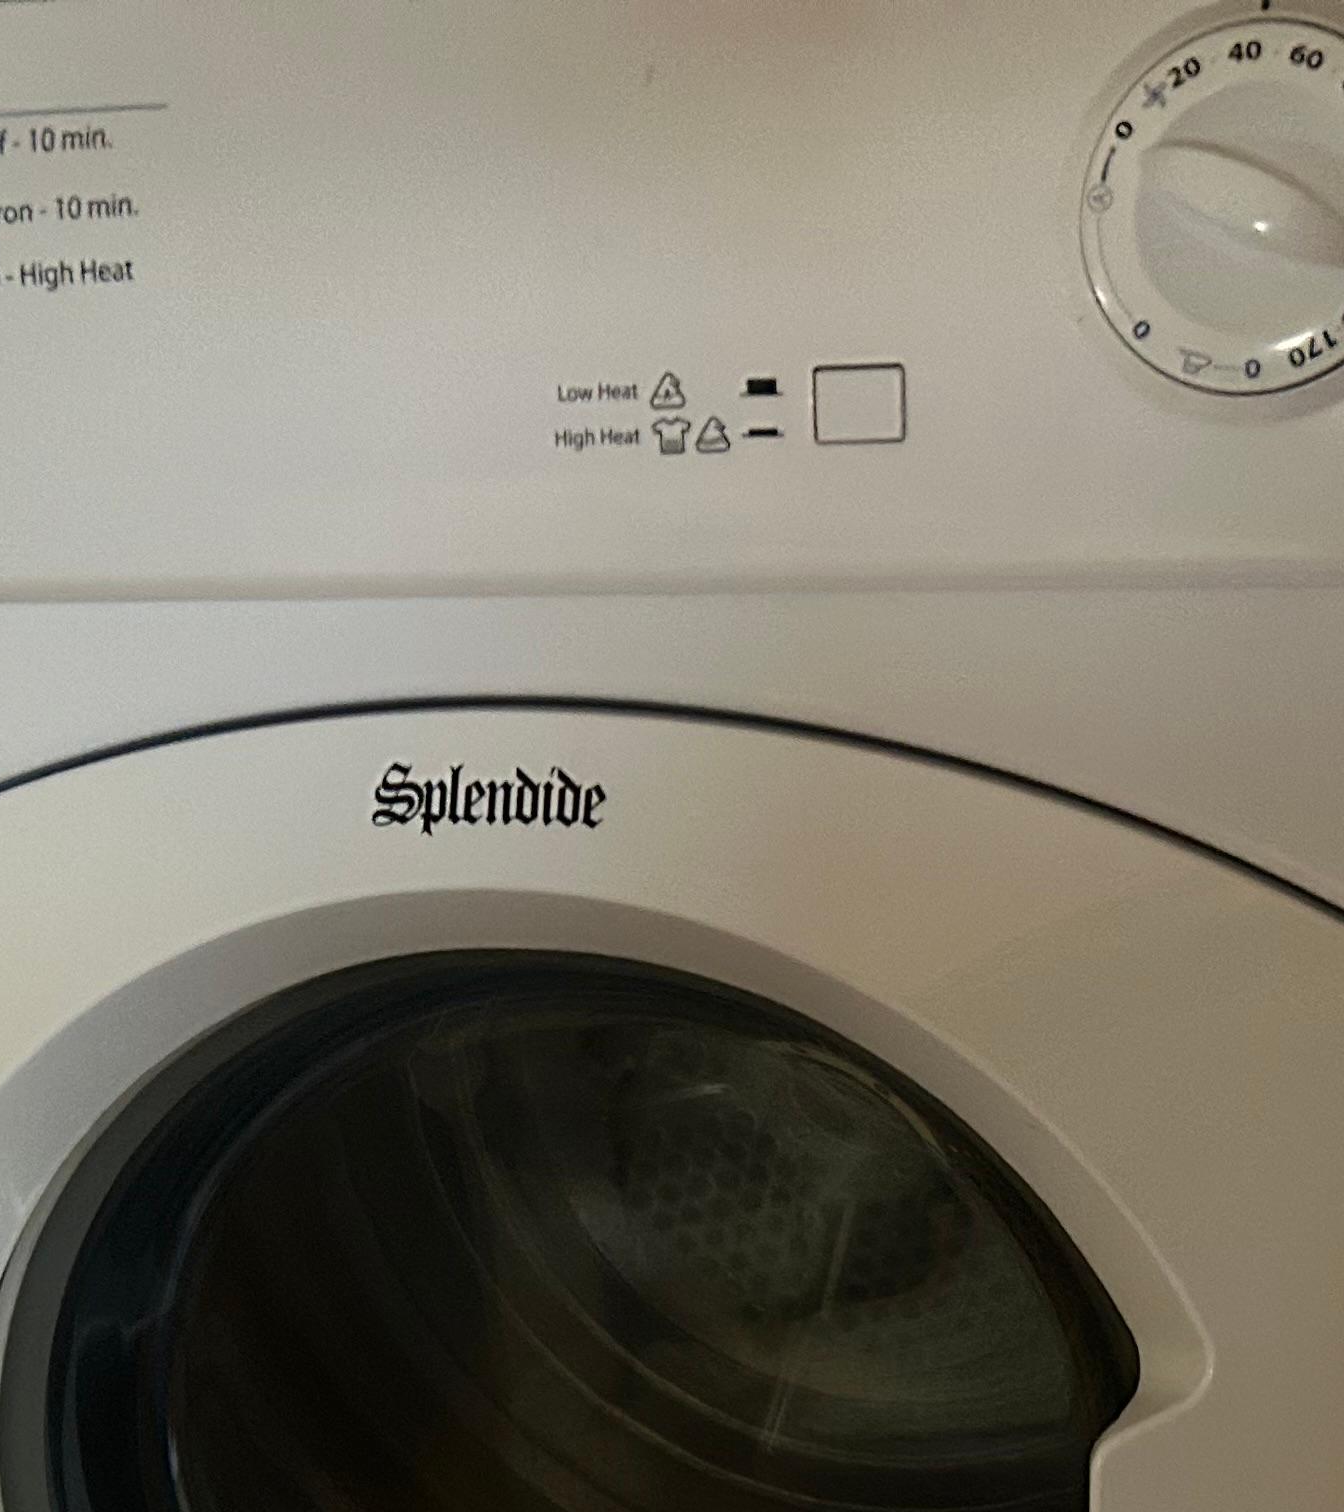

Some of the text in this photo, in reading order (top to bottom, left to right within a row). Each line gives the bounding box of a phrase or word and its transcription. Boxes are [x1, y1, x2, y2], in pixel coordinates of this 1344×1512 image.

[1227, 40, 1263, 64] 40
[1289, 44, 1325, 71] 60
[1167, 56, 1201, 89] 20
[29, 126, 56, 153] 10
[61, 125, 113, 151] min.
[1115, 120, 1133, 140] 0
[55, 194, 82, 221] 10
[87, 193, 140, 220] min.
[19, 260, 74, 291] High
[79, 258, 134, 284] Heat
[1132, 319, 1151, 340] 0
[1288, 329, 1338, 368] 170
[1244, 358, 1261, 379] 0
[557, 381, 638, 402] Low Heat
[554, 426, 640, 452] High Heat
[372, 762, 607, 836] Splendide
